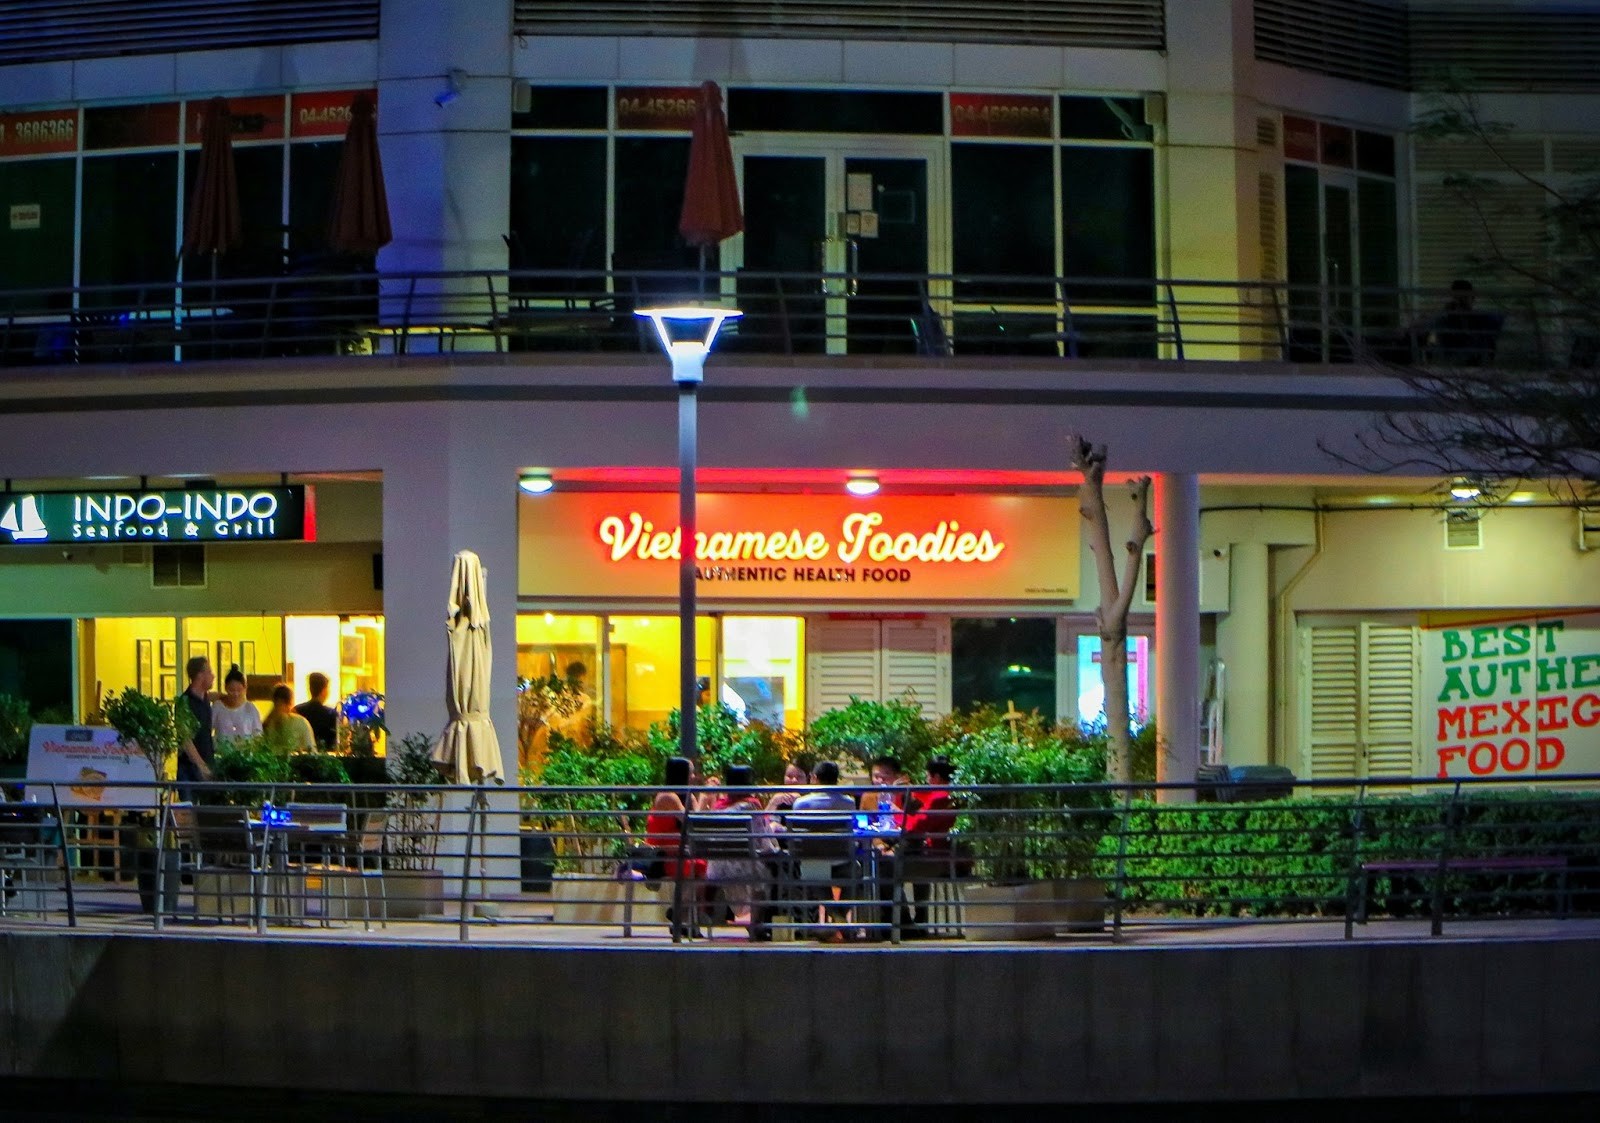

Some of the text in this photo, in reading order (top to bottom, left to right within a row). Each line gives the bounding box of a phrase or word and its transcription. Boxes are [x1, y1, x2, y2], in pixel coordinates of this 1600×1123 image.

[72, 518, 276, 538] Seafood & Grill
[73, 491, 278, 522] INDO-INDO
[837, 511, 1006, 564] Foodies
[793, 567, 856, 582] HEALTH
[863, 568, 912, 583] FOOD
[1442, 619, 1565, 663] BEST
[1437, 654, 1600, 702] AUTHE
[1437, 693, 1600, 742] MEXIC
[1437, 736, 1566, 780] FOOD
